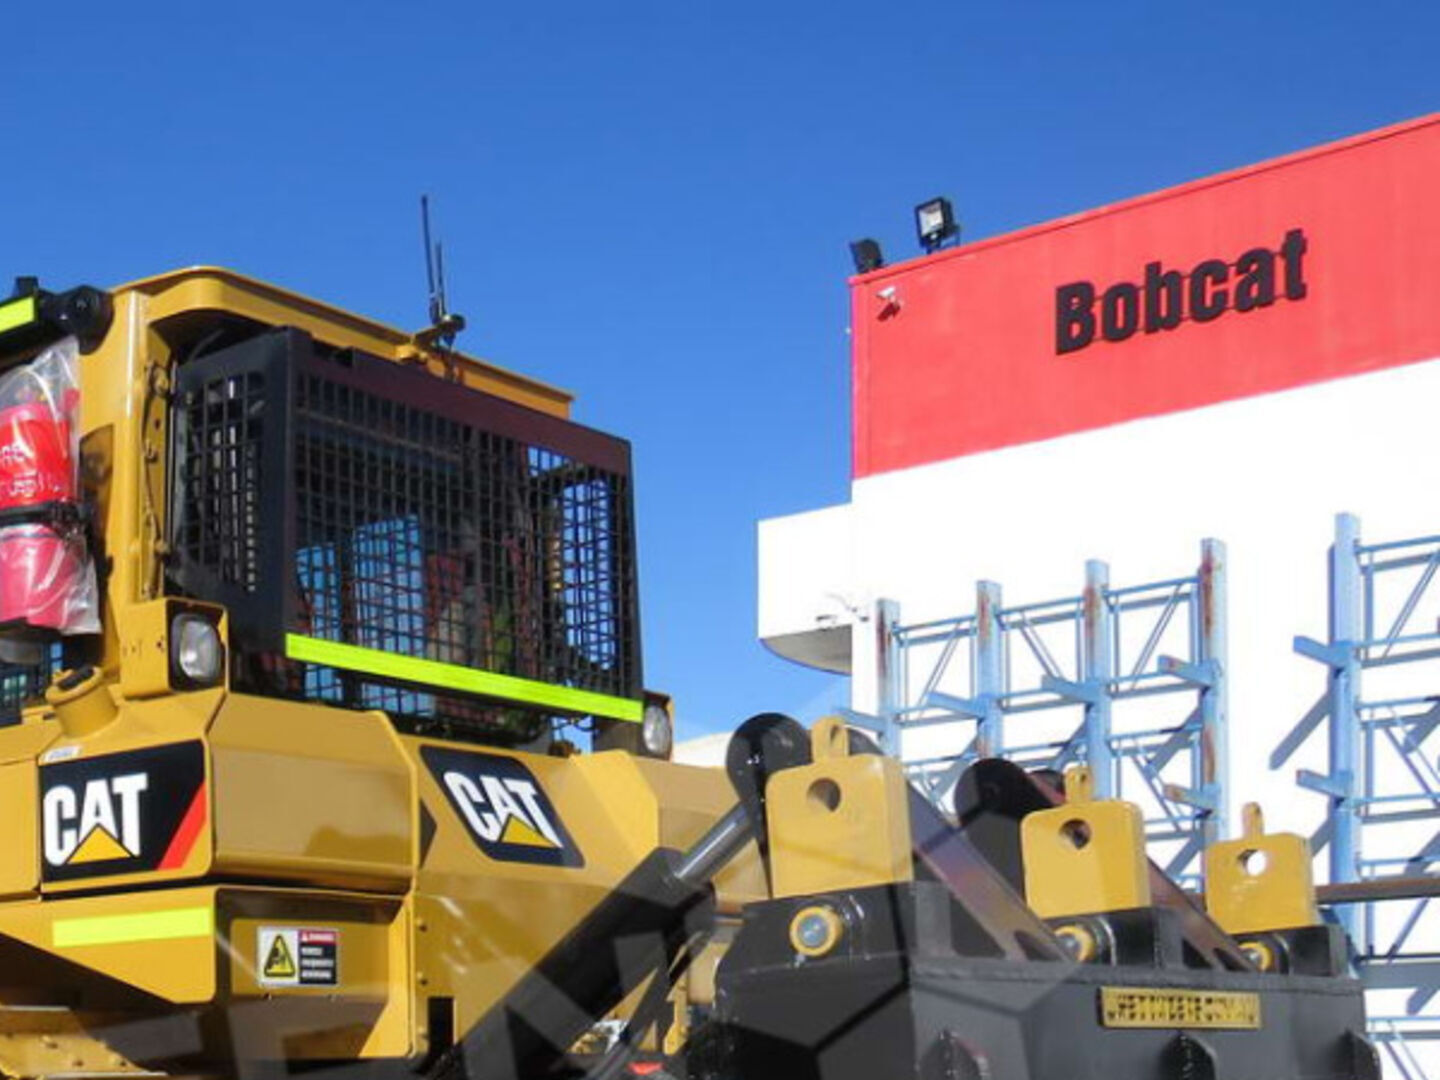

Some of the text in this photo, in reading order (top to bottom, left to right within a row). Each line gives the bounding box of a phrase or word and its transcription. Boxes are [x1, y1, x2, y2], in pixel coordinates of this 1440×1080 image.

[1055, 228, 1308, 355] Bobcat
[43, 772, 149, 867] CAT
[443, 771, 563, 848] CAT
